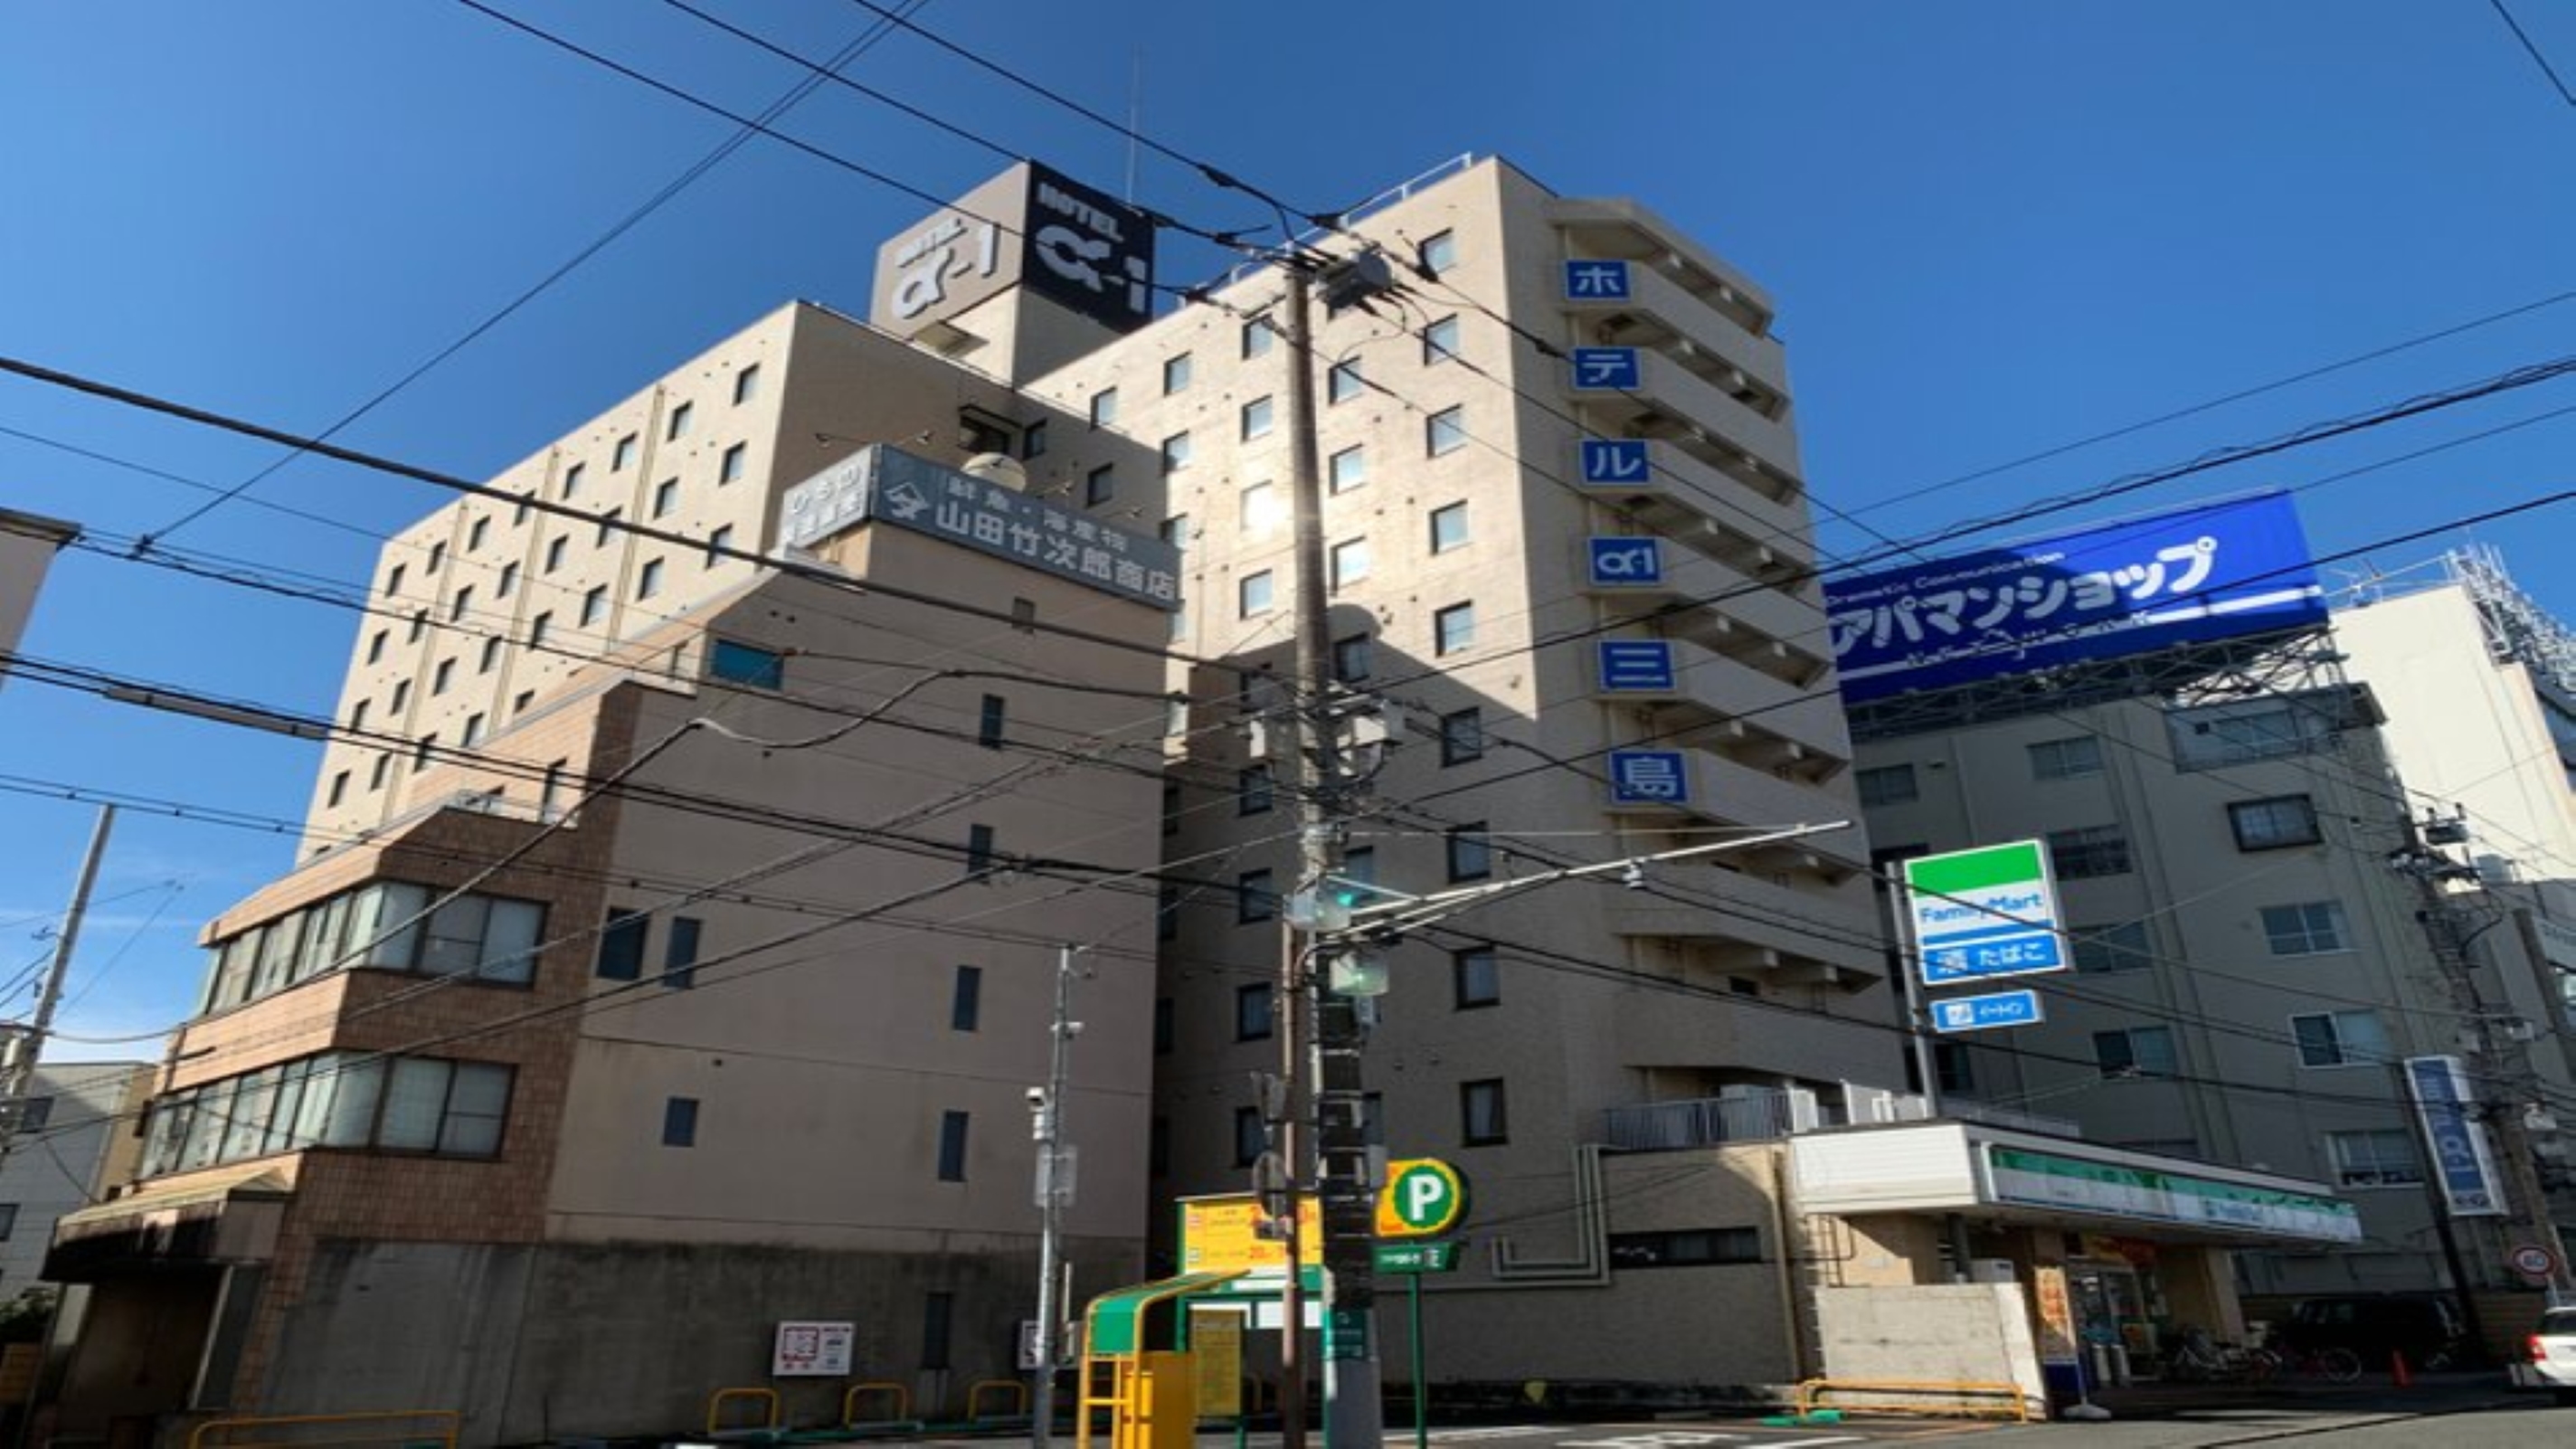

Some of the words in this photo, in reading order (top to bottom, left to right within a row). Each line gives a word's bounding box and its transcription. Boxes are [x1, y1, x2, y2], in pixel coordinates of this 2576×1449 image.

[1038, 183, 1124, 242] HOTEL
[1828, 535, 2218, 656] アパマンショップ
[1921, 893, 2041, 921] FamMart
[1409, 1174, 1444, 1221] P
